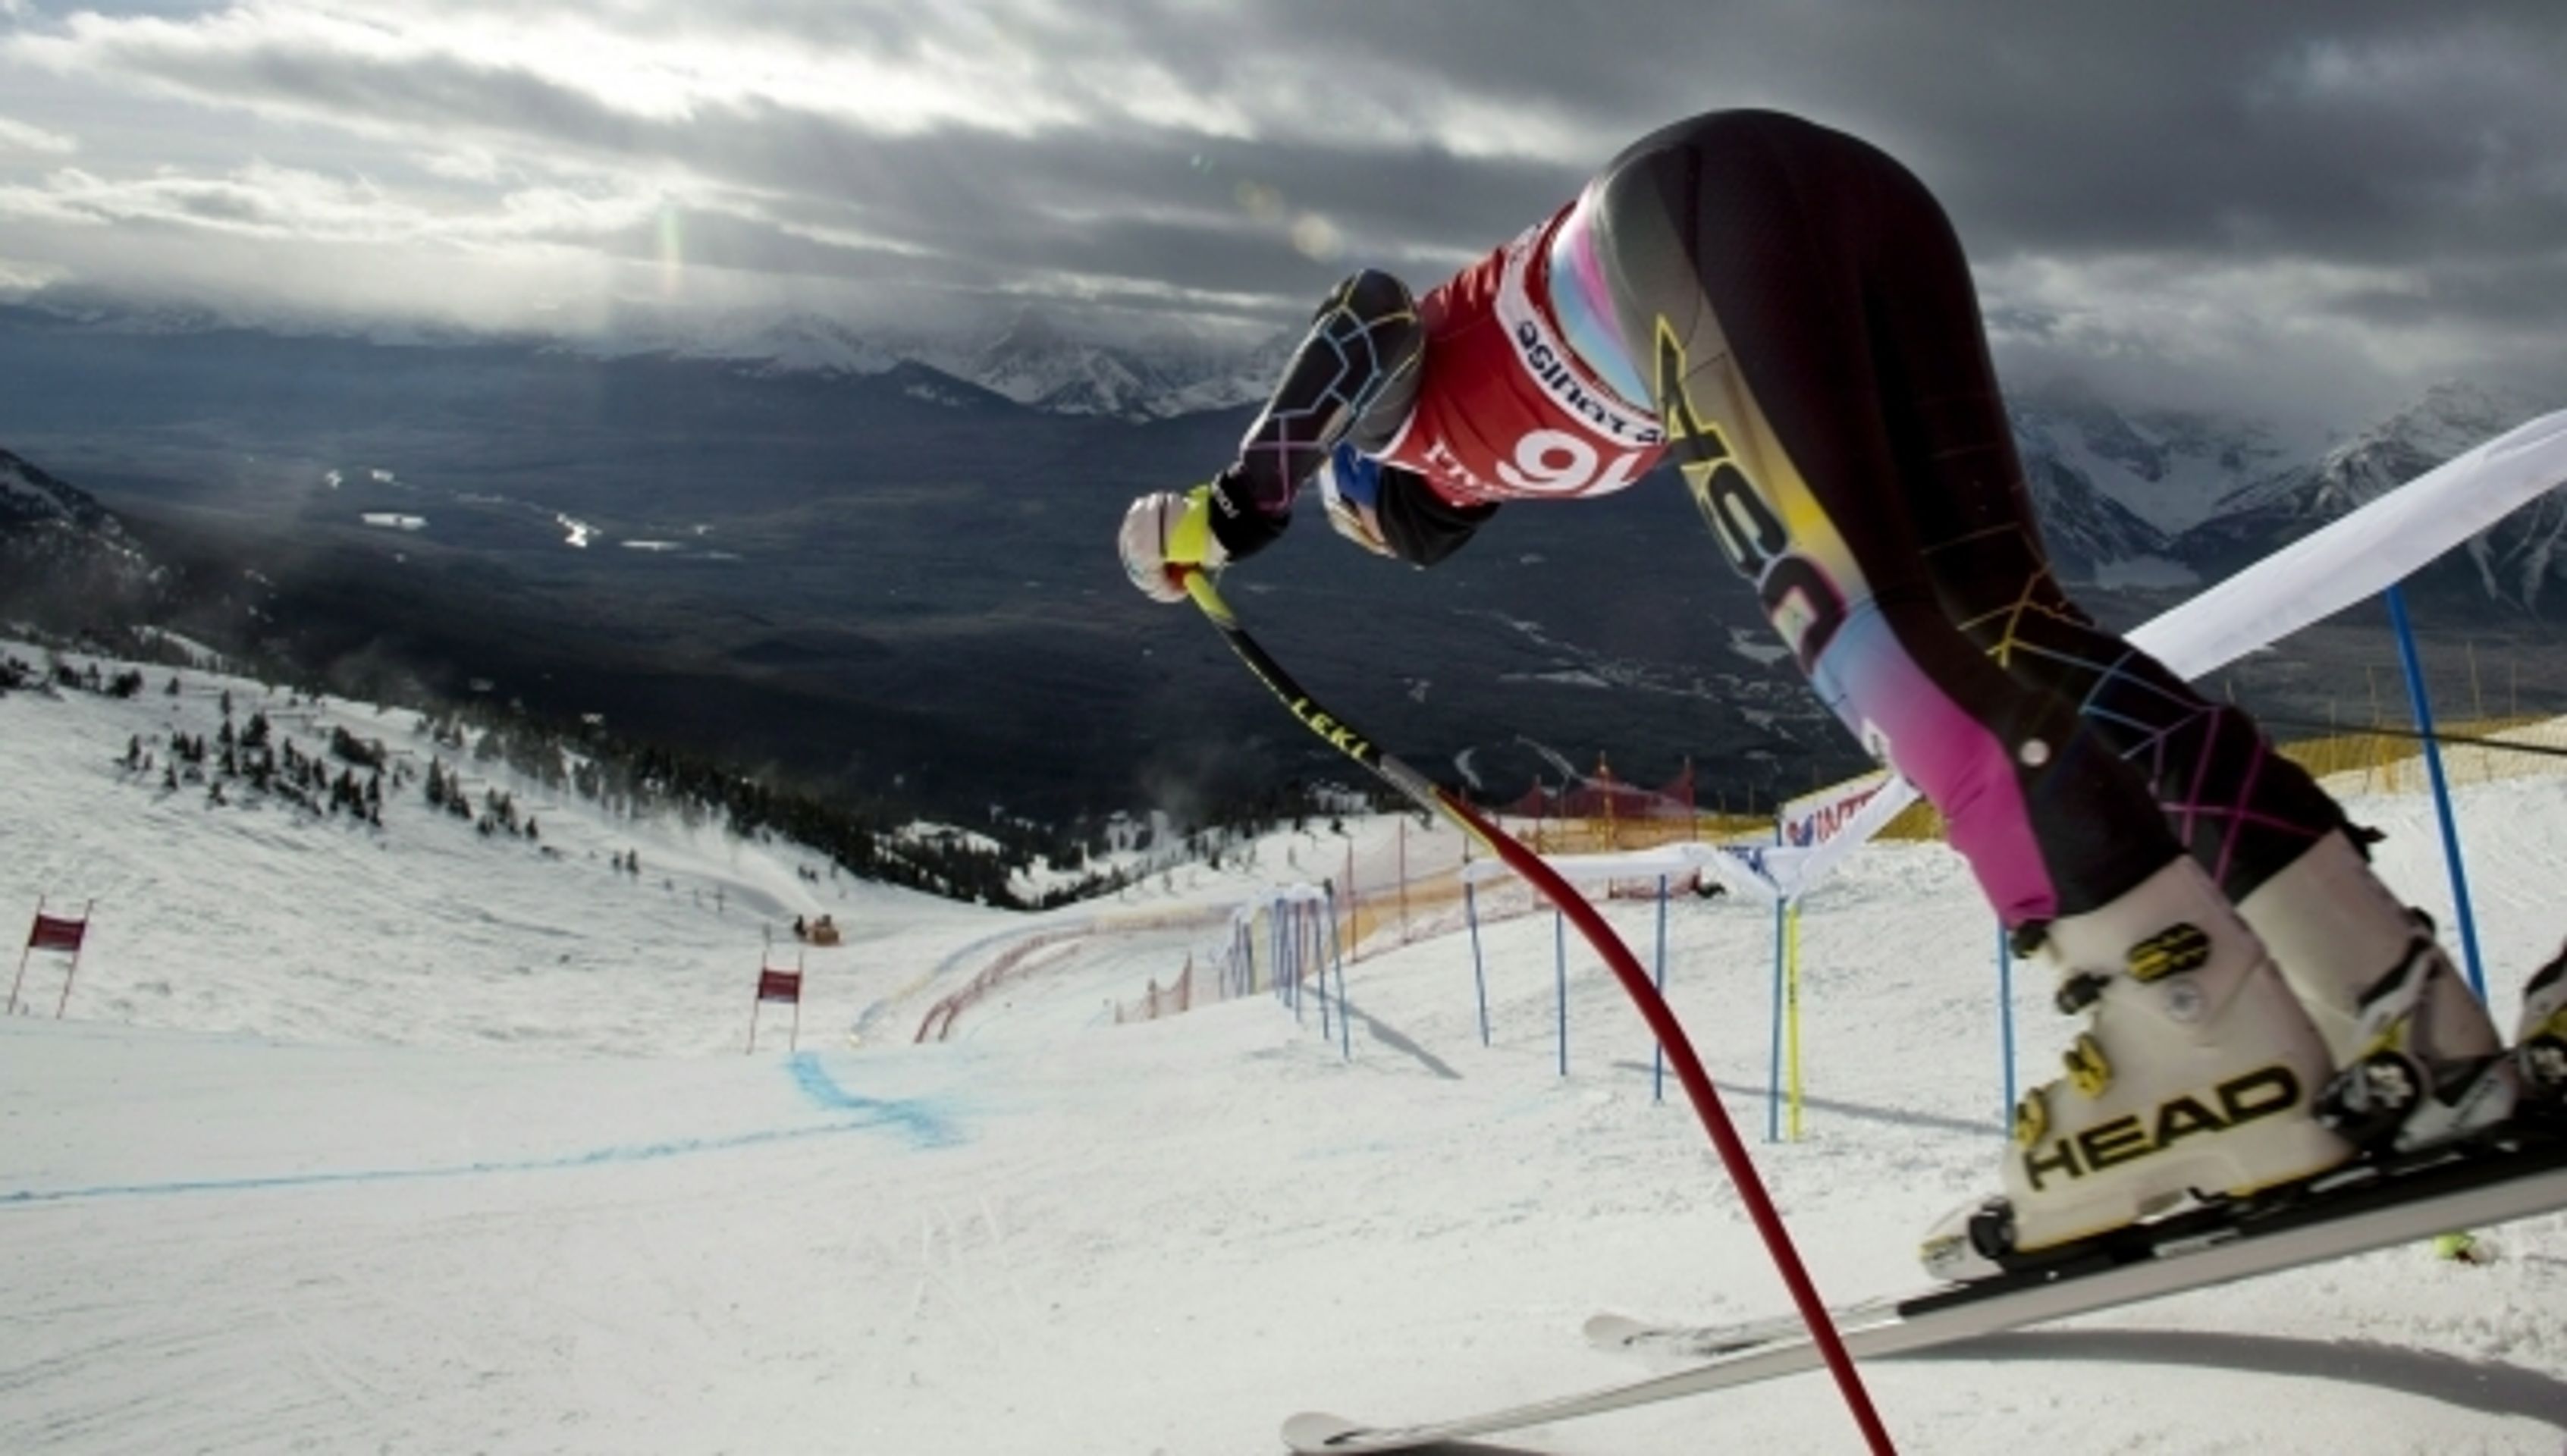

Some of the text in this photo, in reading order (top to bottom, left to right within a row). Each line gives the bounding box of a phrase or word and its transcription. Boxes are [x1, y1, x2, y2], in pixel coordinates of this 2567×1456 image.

[1496, 429, 1644, 497] 16
[1656, 313, 1848, 673] USA
[1291, 697, 1372, 761] LEKI
[2024, 1065, 2302, 1191] HEAD
